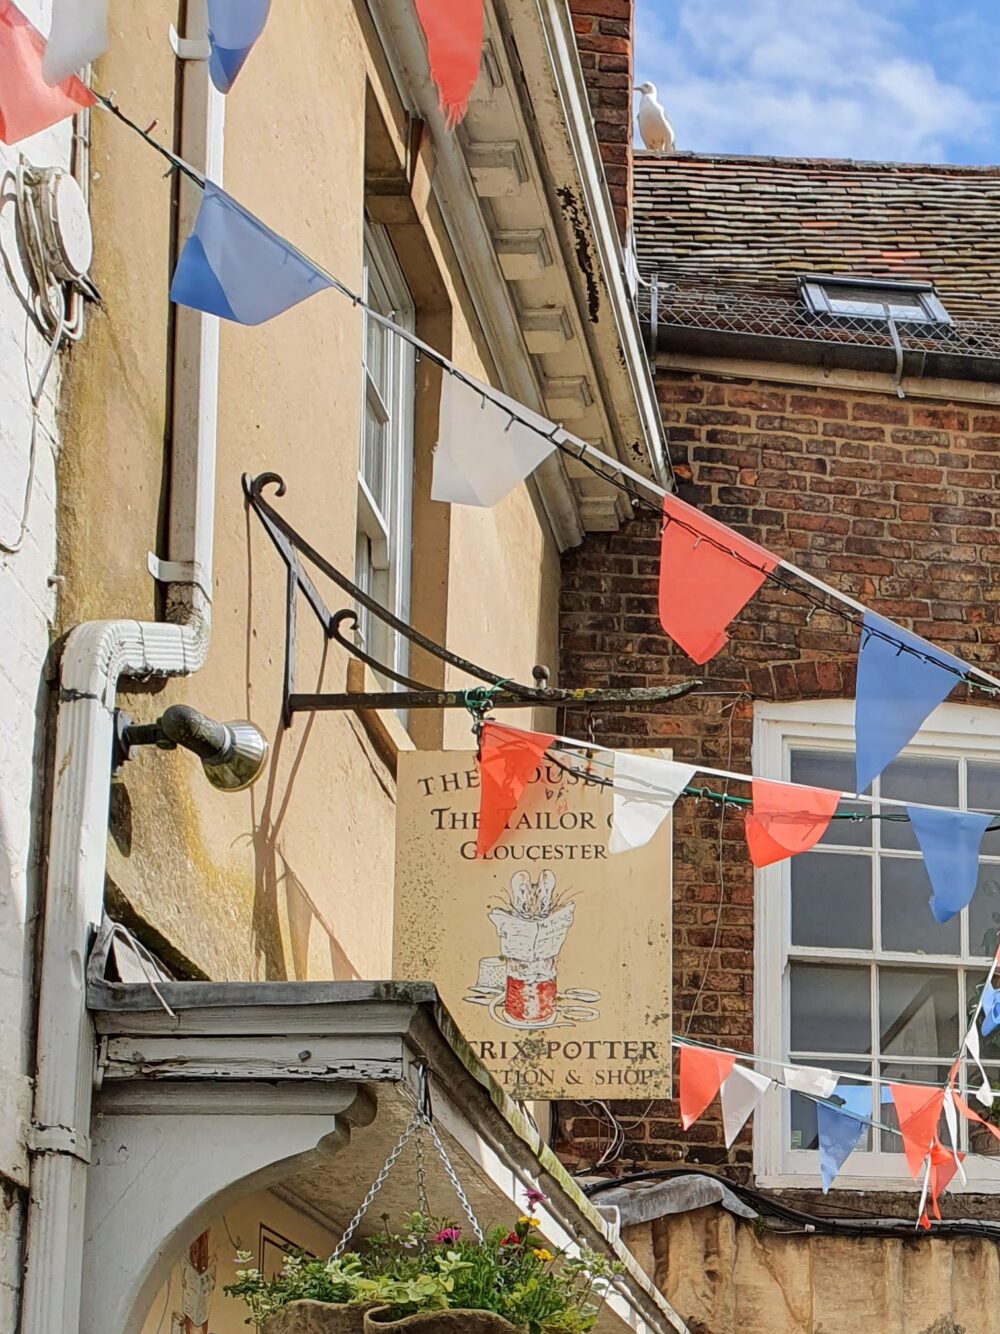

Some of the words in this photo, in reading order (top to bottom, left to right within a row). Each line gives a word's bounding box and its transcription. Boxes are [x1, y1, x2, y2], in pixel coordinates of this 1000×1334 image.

[418, 768, 481, 797] THE
[460, 840, 608, 861] GLOUCESTER
[546, 1040, 659, 1060] POTTER
[488, 1068, 555, 1087] TION
[565, 1068, 583, 1086] &
[595, 1068, 653, 1086] SHOP
